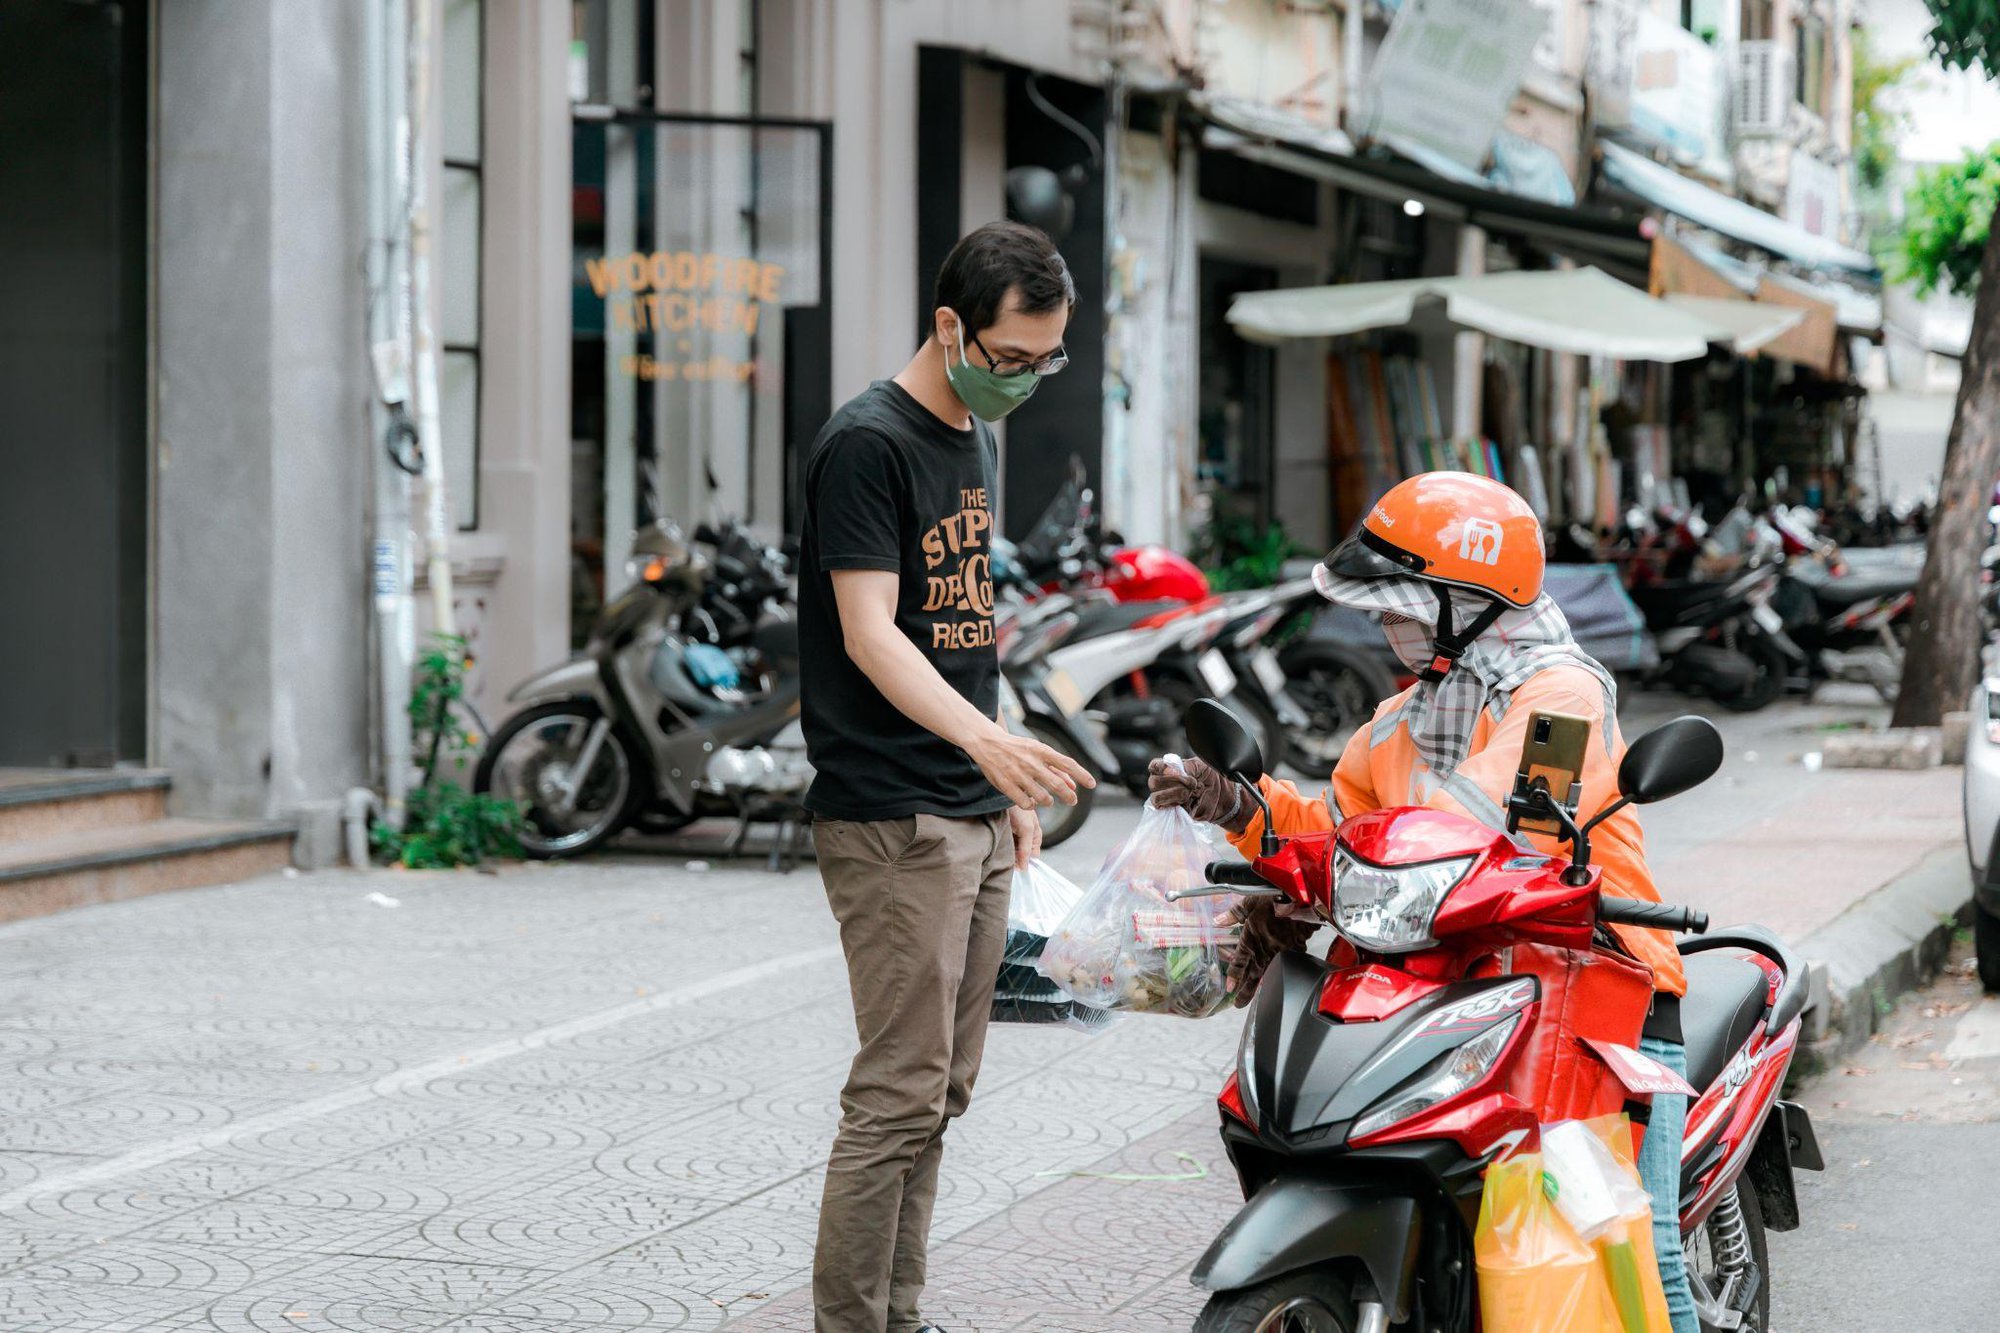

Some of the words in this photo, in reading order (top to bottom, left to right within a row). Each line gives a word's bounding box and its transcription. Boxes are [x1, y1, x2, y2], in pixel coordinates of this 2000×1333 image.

[585, 251, 785, 302] WOODFIRE
[613, 294, 760, 338] KITCHEN
[960, 487, 988, 508] THE
[1346, 971, 1392, 985] HONDA
